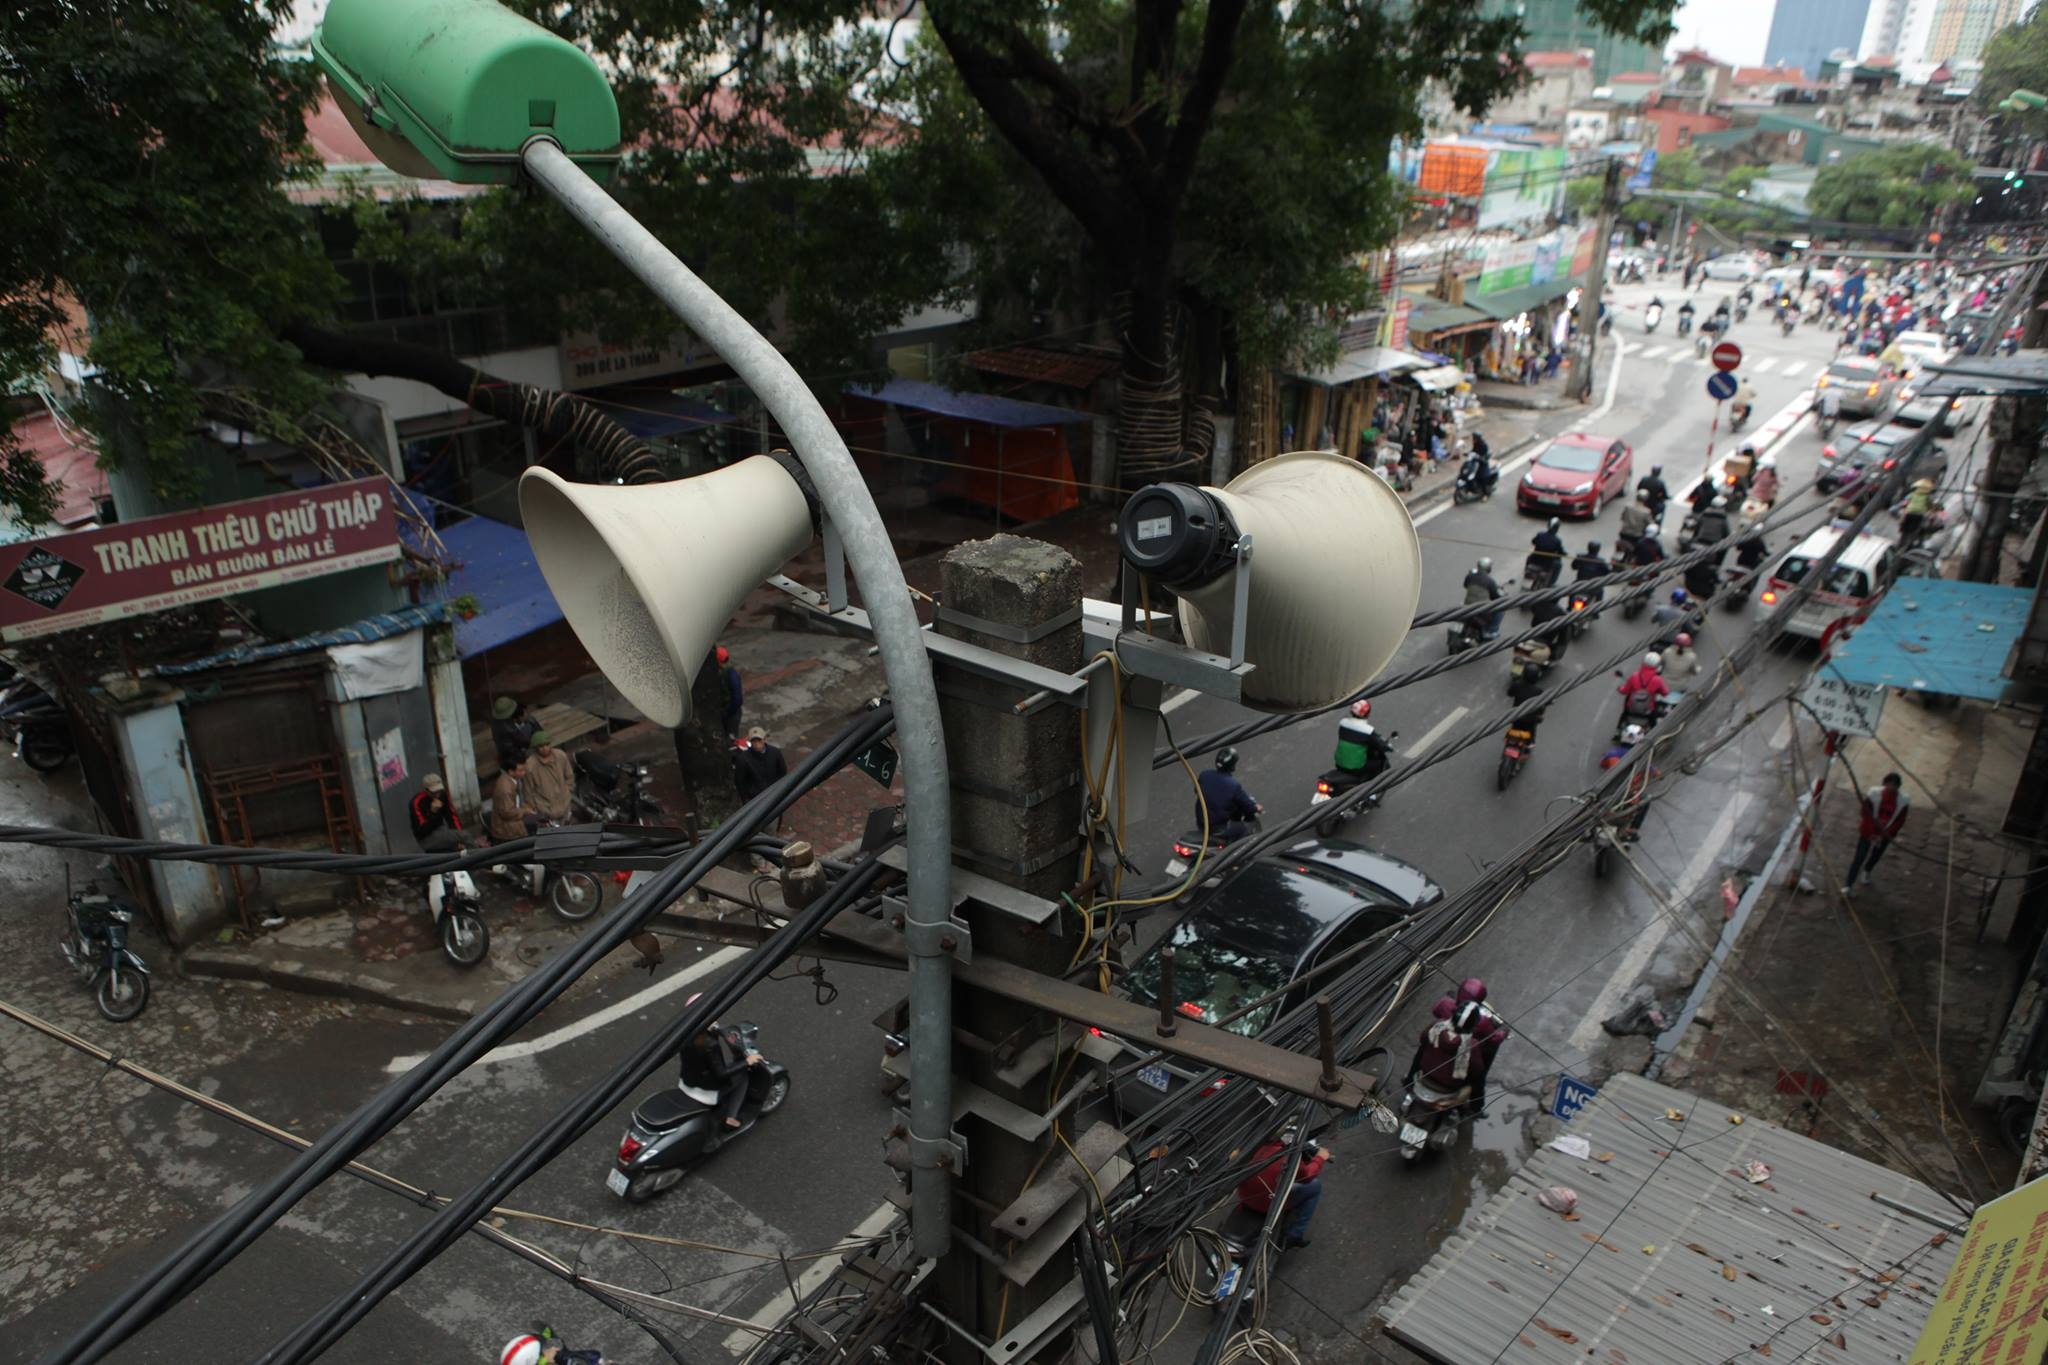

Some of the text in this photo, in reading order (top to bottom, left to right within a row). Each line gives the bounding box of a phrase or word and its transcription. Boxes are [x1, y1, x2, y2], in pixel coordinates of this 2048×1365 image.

[93, 490, 383, 575] TRANH THÊU CHỮ THẬP
[217, 551, 268, 577] BUÔN
[314, 533, 336, 556] LẺ
